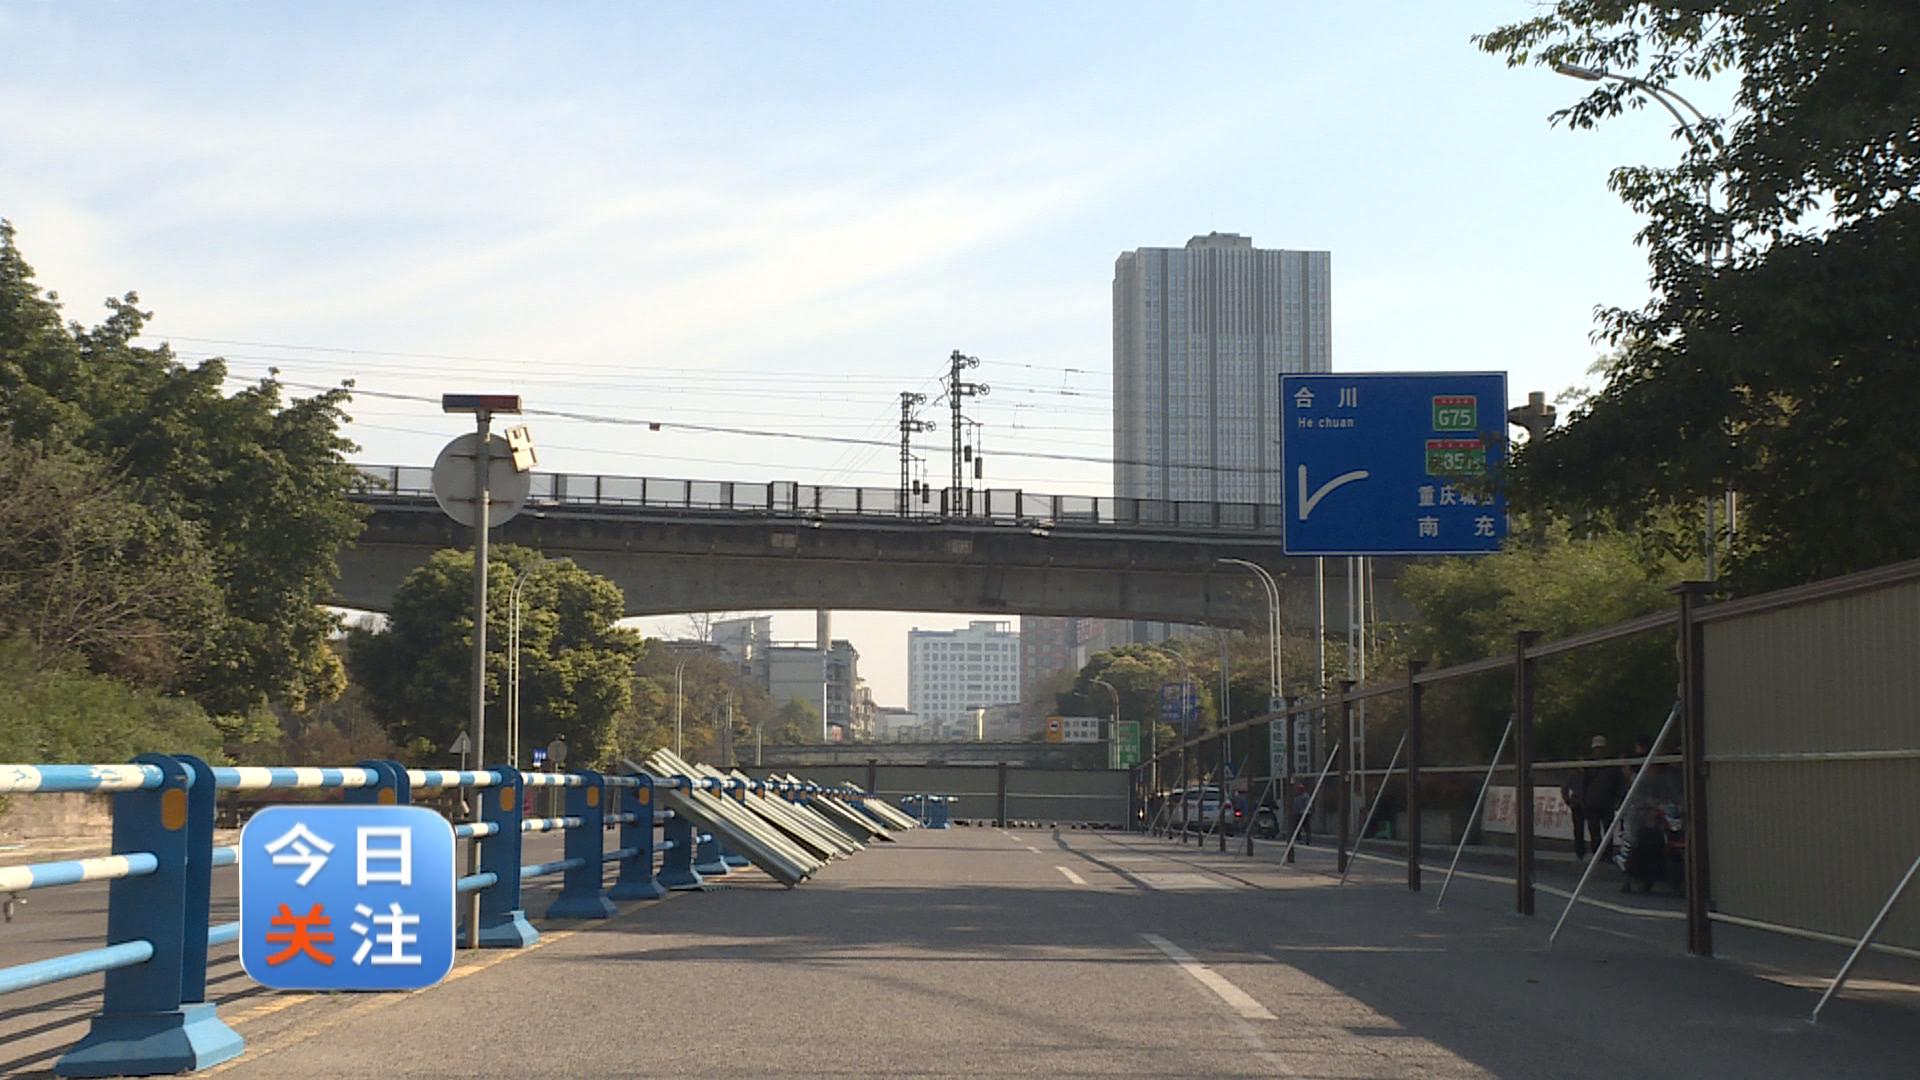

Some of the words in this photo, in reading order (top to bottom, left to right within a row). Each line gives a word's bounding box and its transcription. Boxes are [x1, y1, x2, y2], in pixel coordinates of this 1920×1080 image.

[1293, 386, 1358, 408] 合川
[1297, 416, 1314, 428] He
[1318, 417, 1354, 428] chuan
[1438, 408, 1472, 426] G75
[1417, 515, 1497, 538] 南充
